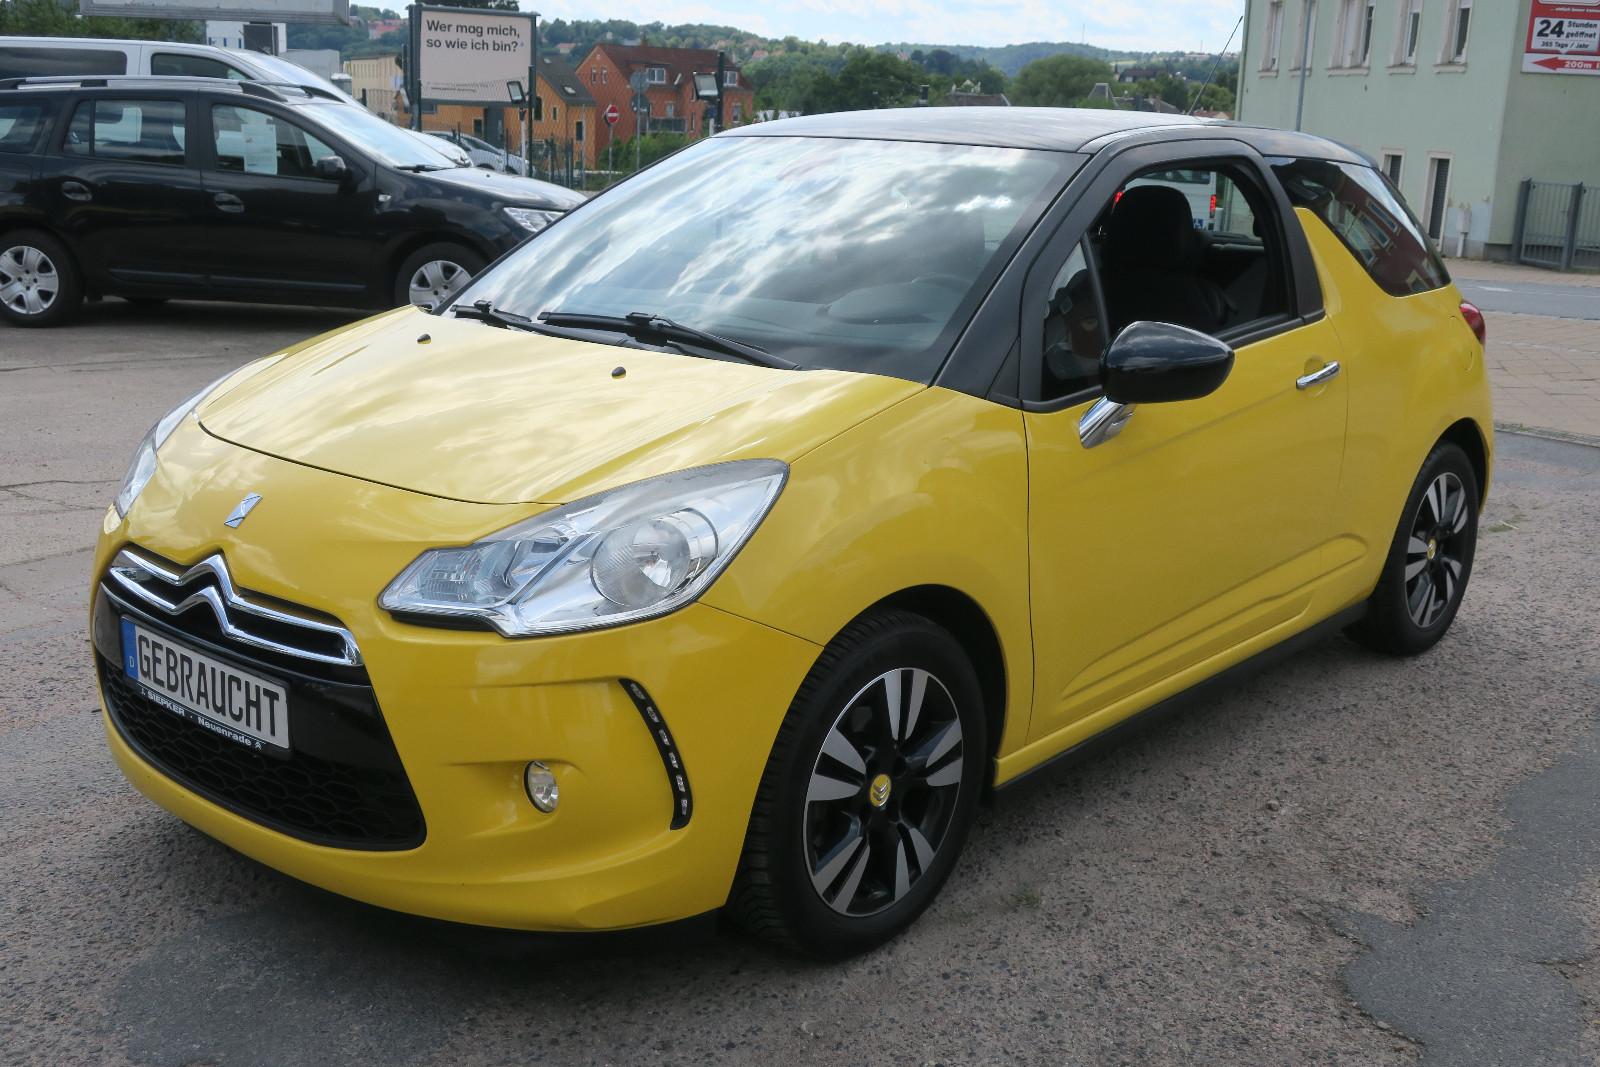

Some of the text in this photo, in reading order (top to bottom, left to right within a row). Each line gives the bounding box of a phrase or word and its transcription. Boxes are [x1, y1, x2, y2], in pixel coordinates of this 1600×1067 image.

[426, 19, 520, 39] Wer mag mich,
[1536, 19, 1565, 38] 24
[1565, 31, 1597, 39] geöffnet
[426, 38, 441, 48] so
[445, 38, 468, 49] wie
[471, 39, 489, 51] ich
[1565, 61, 1592, 69] 200m
[129, 656, 135, 668] D
[138, 634, 279, 737] GEBRAUCHT
[147, 690, 185, 716] SIEPKER
